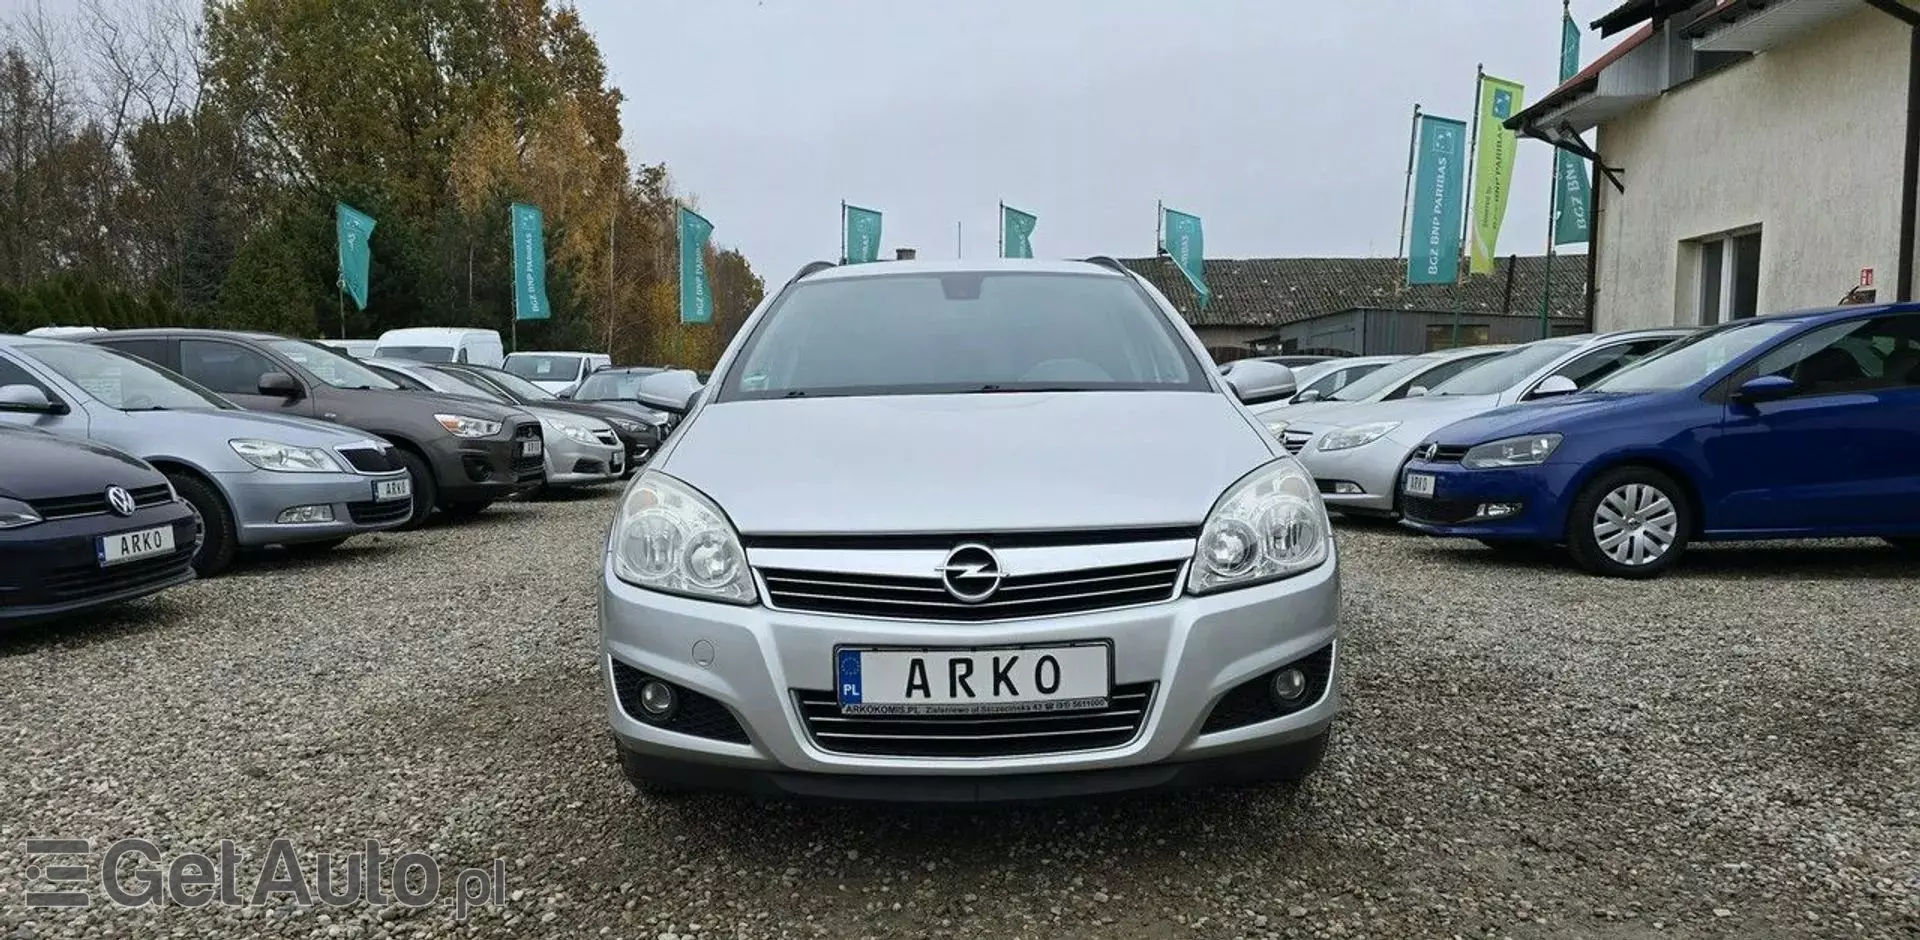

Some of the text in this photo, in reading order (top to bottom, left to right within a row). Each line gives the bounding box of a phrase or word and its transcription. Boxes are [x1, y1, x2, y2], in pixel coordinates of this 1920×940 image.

[1430, 216, 1441, 246] BNP
[1436, 156, 1447, 215] PARIBAS
[121, 530, 162, 556] ARKO
[843, 684, 860, 696] PL
[905, 655, 1061, 698] ARKO
